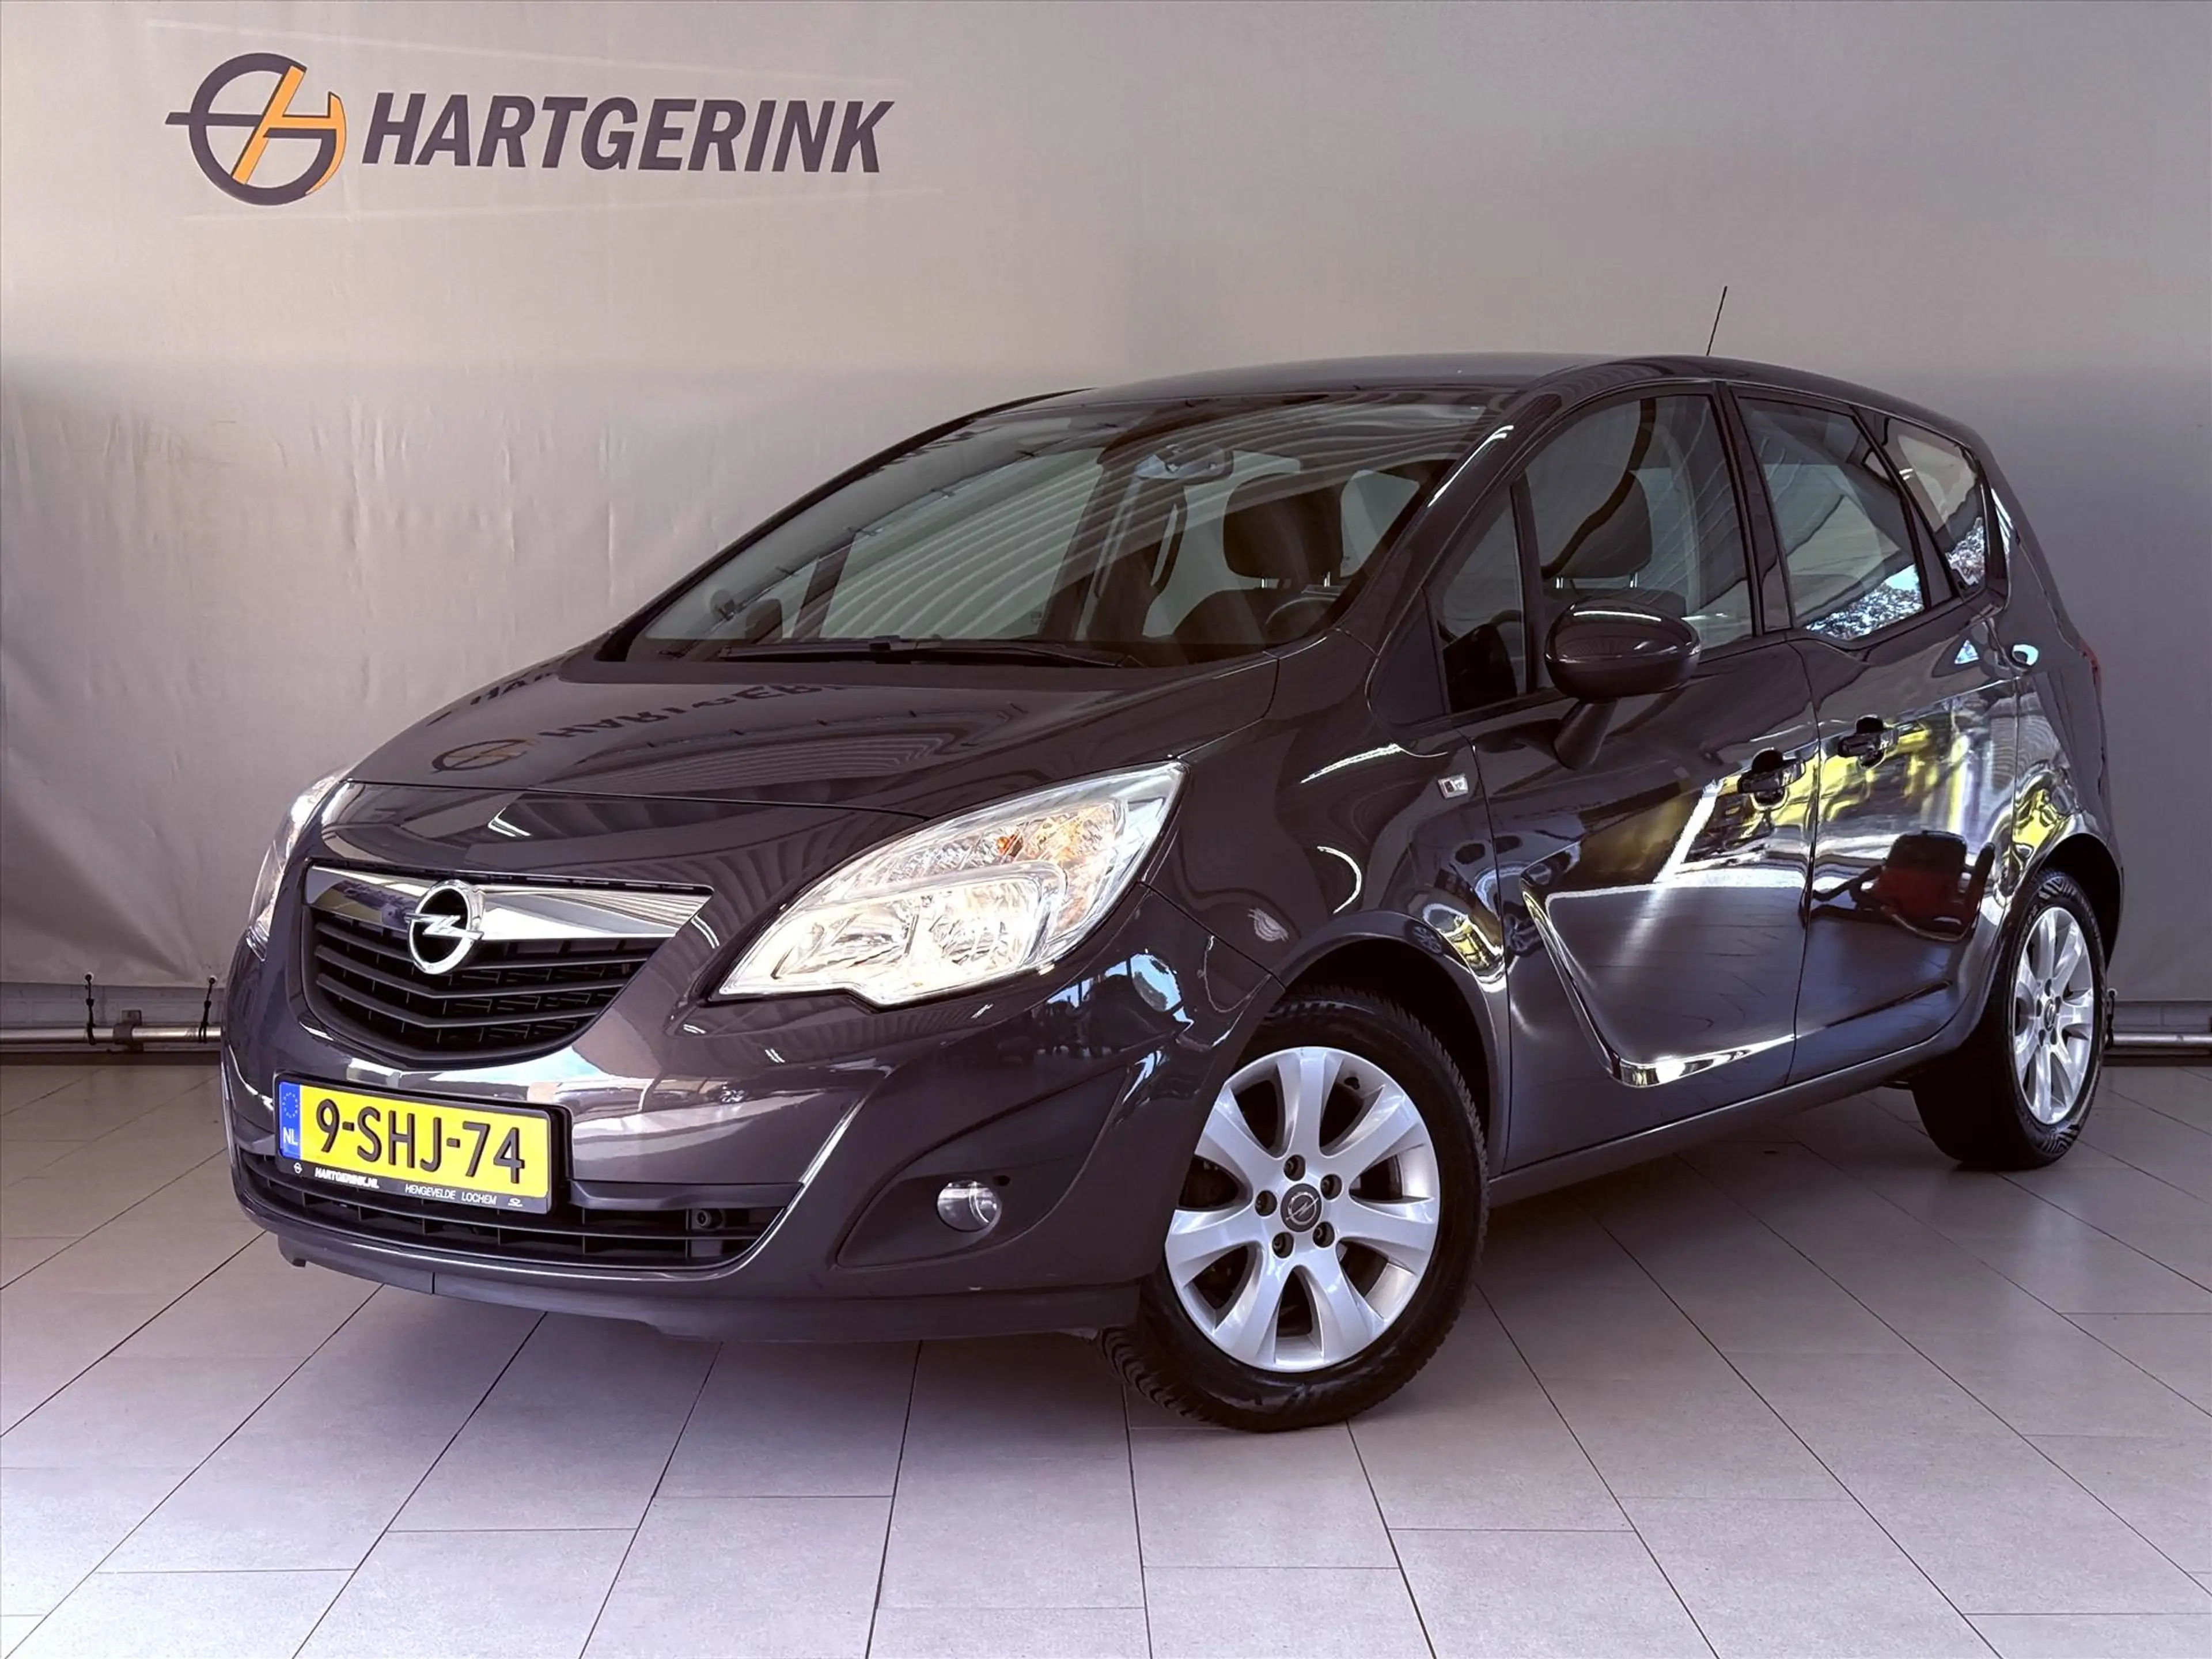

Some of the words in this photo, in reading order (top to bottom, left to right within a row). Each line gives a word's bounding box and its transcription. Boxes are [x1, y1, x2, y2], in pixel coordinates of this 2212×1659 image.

[361, 92, 895, 173] HARTGERINK
[283, 1126, 299, 1146] NL
[316, 1098, 525, 1184] 9-SHJ-74
[404, 1184, 457, 1200] HENGEVELDE
[461, 1191, 498, 1206] LOCHEM
